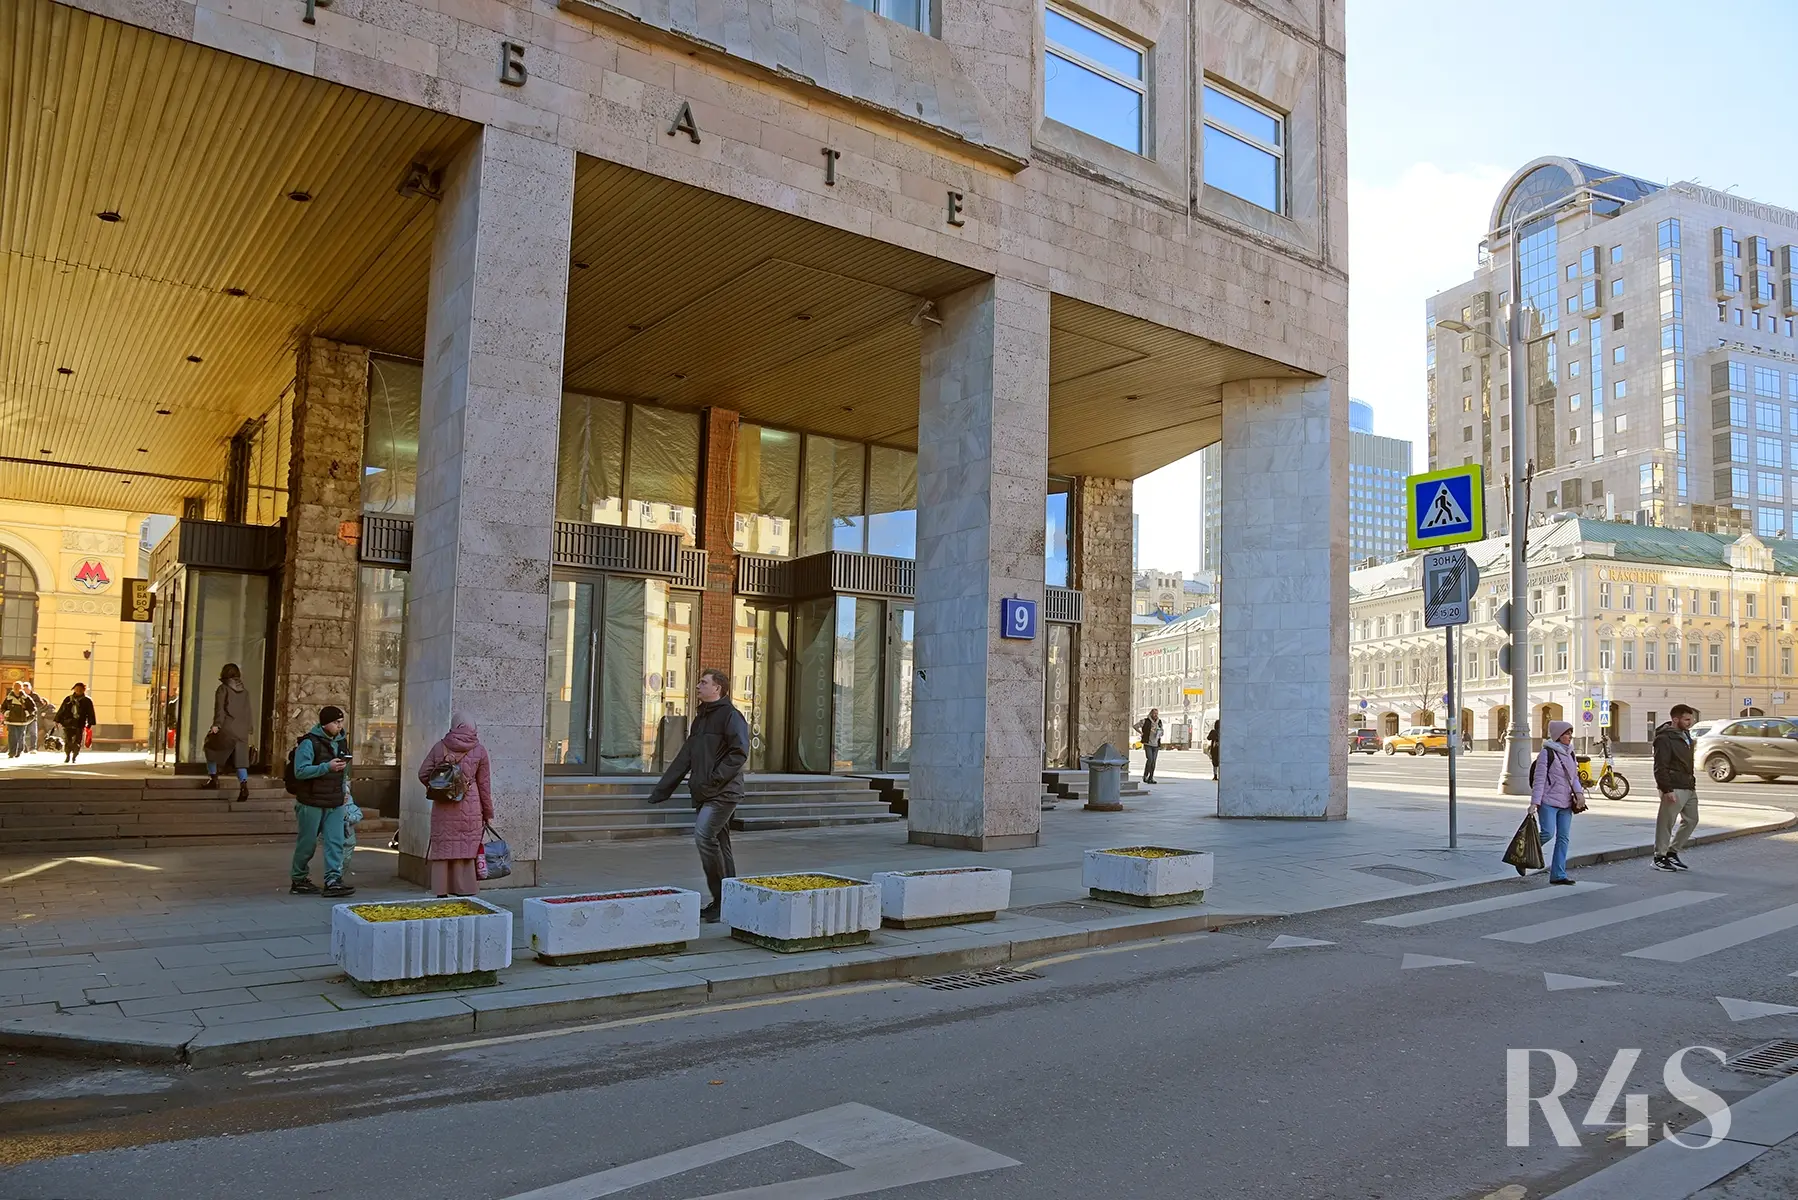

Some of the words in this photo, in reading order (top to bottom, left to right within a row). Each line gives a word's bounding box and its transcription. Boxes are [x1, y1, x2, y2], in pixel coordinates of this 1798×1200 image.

[1433, 555, 1457, 566] ЗОНА
[1449, 607, 1460, 617] 20
[1015, 606, 1029, 631] 9
